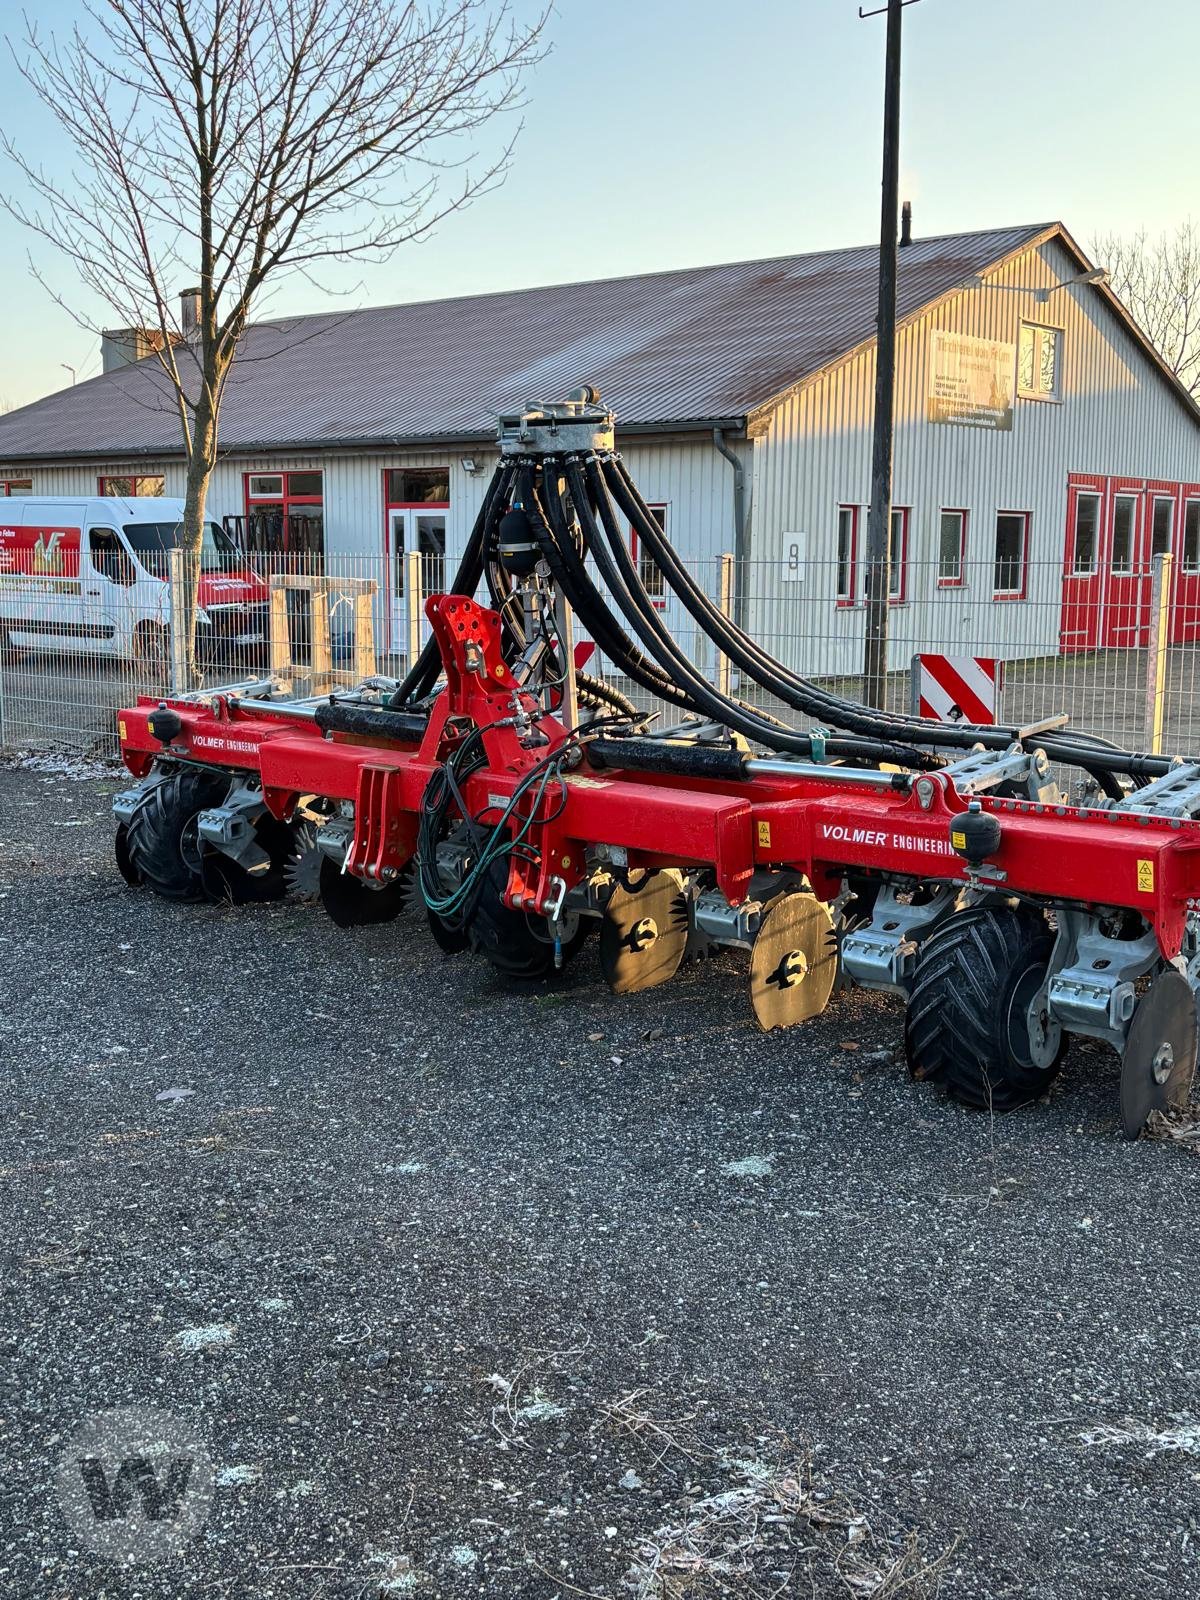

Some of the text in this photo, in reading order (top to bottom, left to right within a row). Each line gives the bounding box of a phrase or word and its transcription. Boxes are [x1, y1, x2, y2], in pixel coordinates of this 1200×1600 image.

[789, 543, 799, 570] 9
[193, 735, 225, 749] VOLMER
[823, 824, 887, 846] VOLMER
[893, 834, 960, 857] ENGINEERIN
